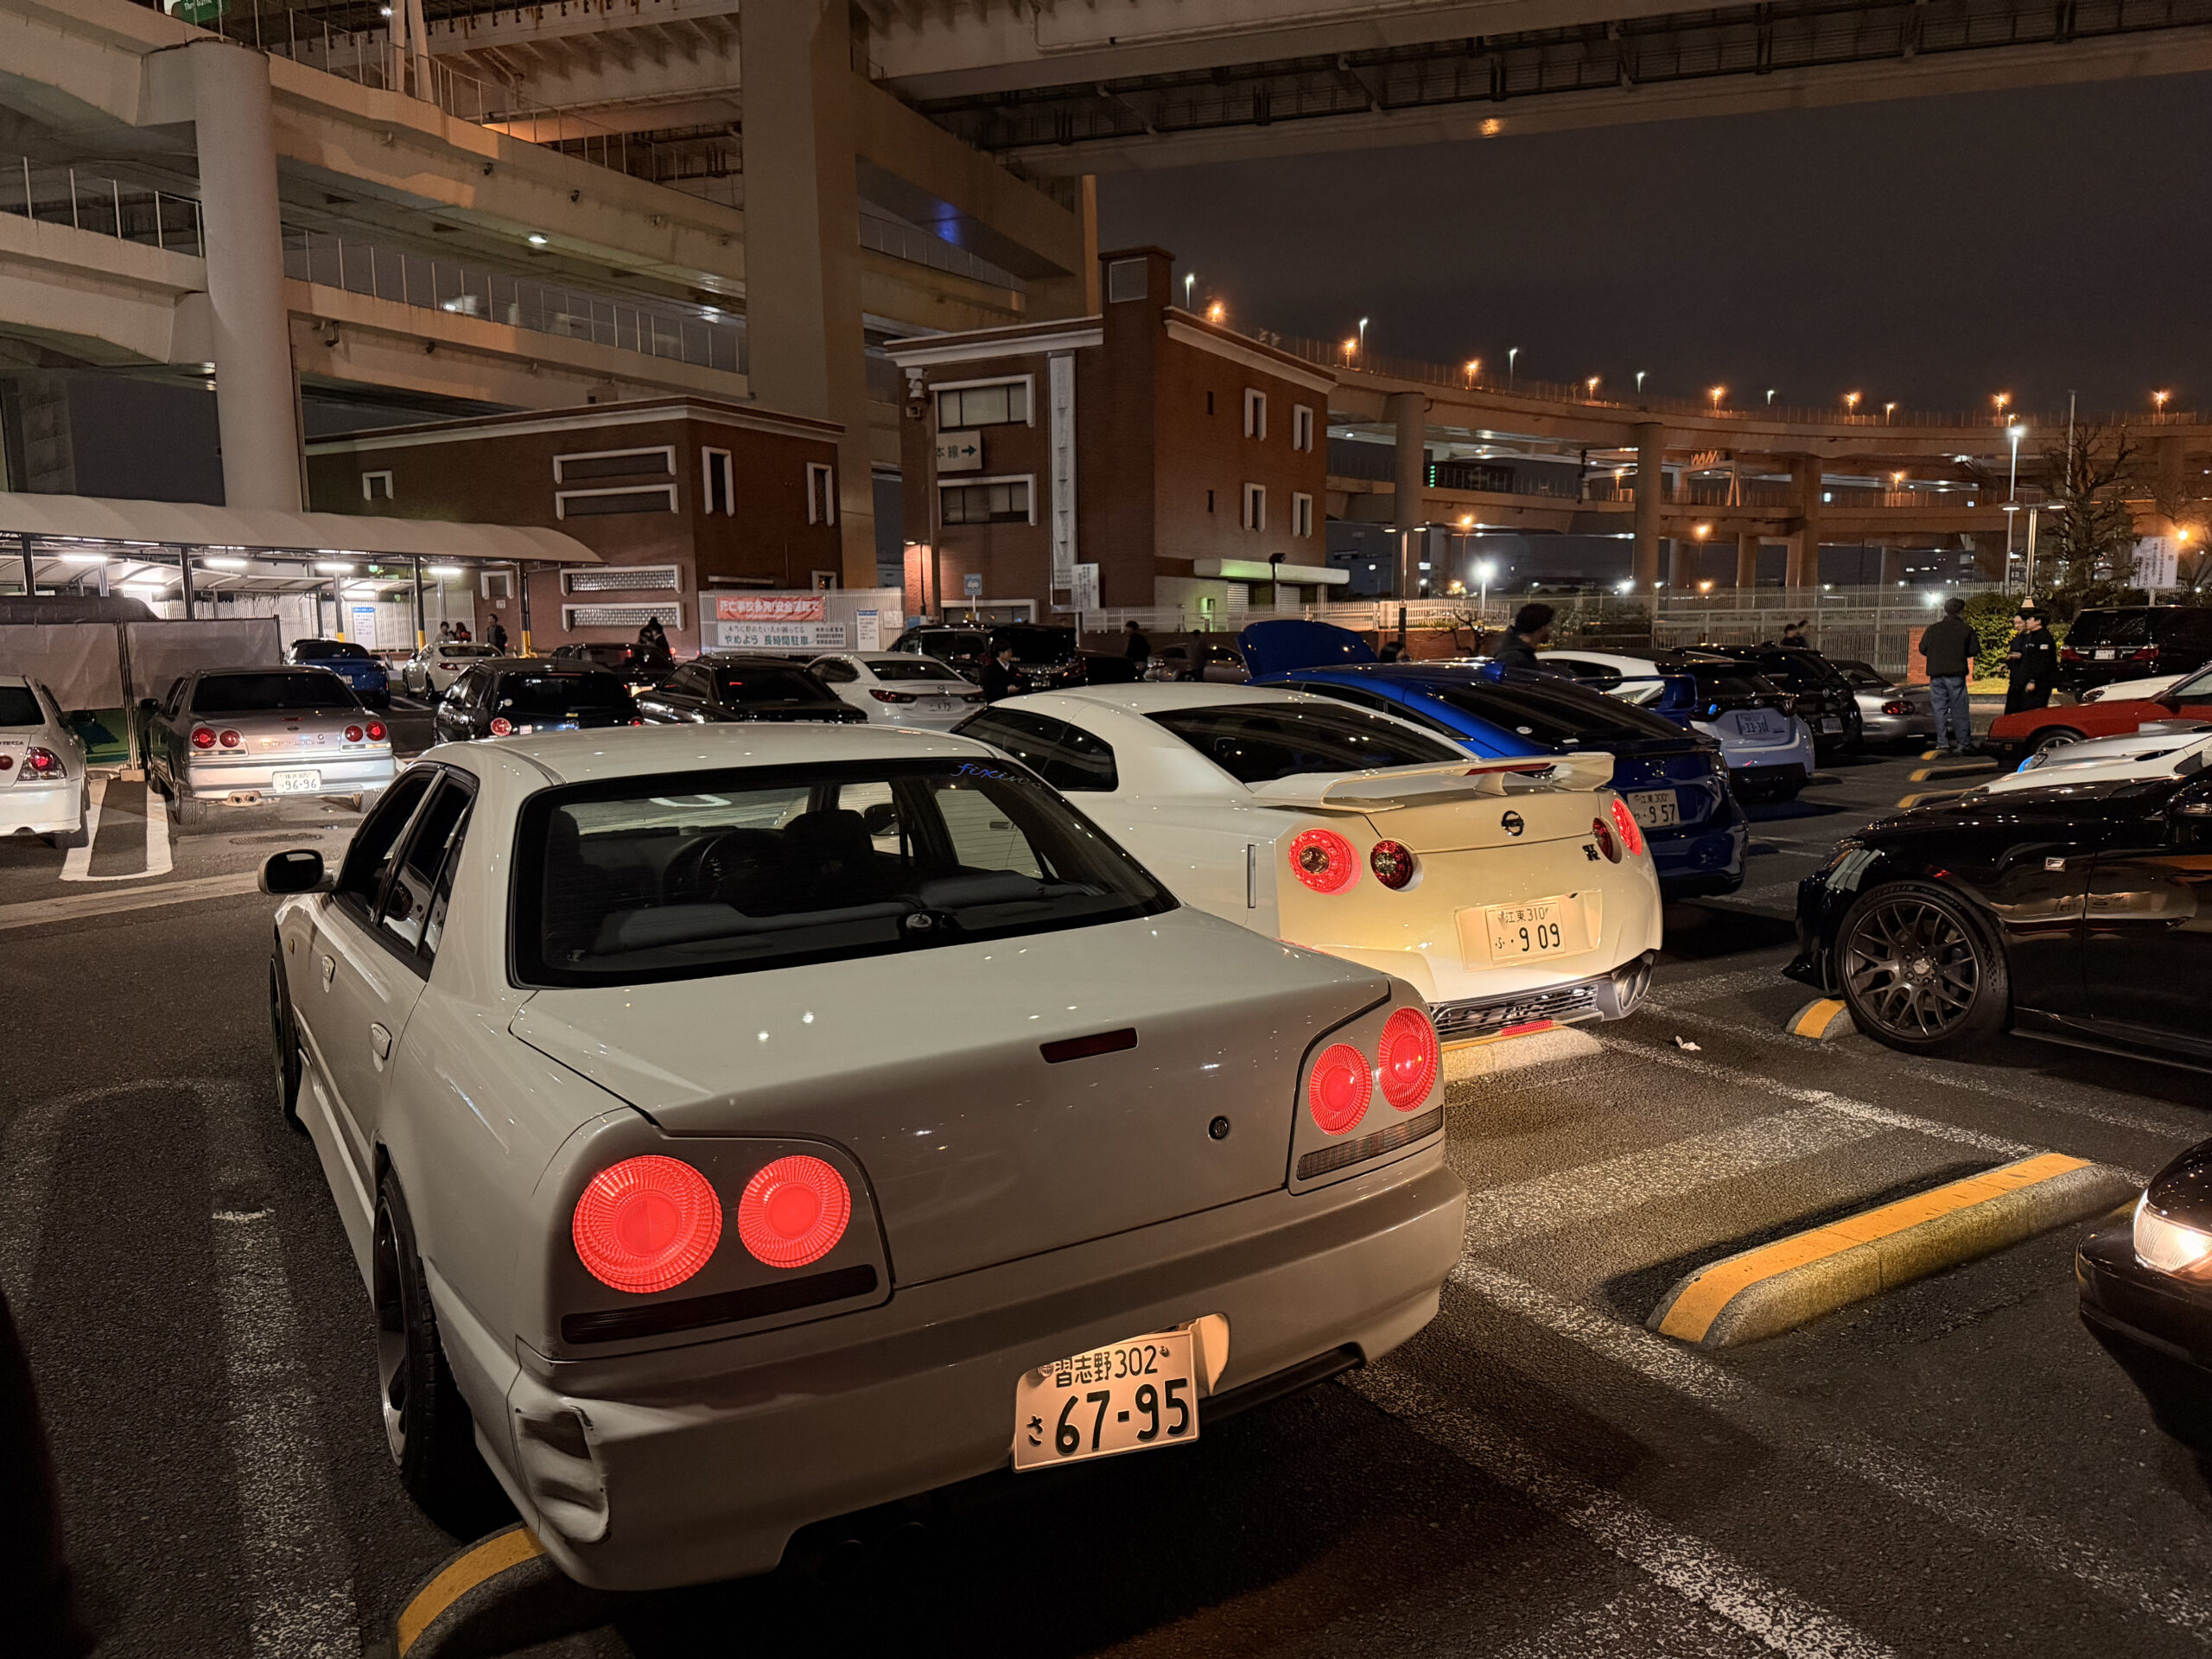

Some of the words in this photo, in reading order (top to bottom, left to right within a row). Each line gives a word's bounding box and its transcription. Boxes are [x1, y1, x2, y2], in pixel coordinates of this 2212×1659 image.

[285, 779, 316, 791] 96-96
[1495, 937, 1505, 949] ふ
[1027, 1415, 1043, 1447] さ
[1055, 1378, 1189, 1455] 67-95
